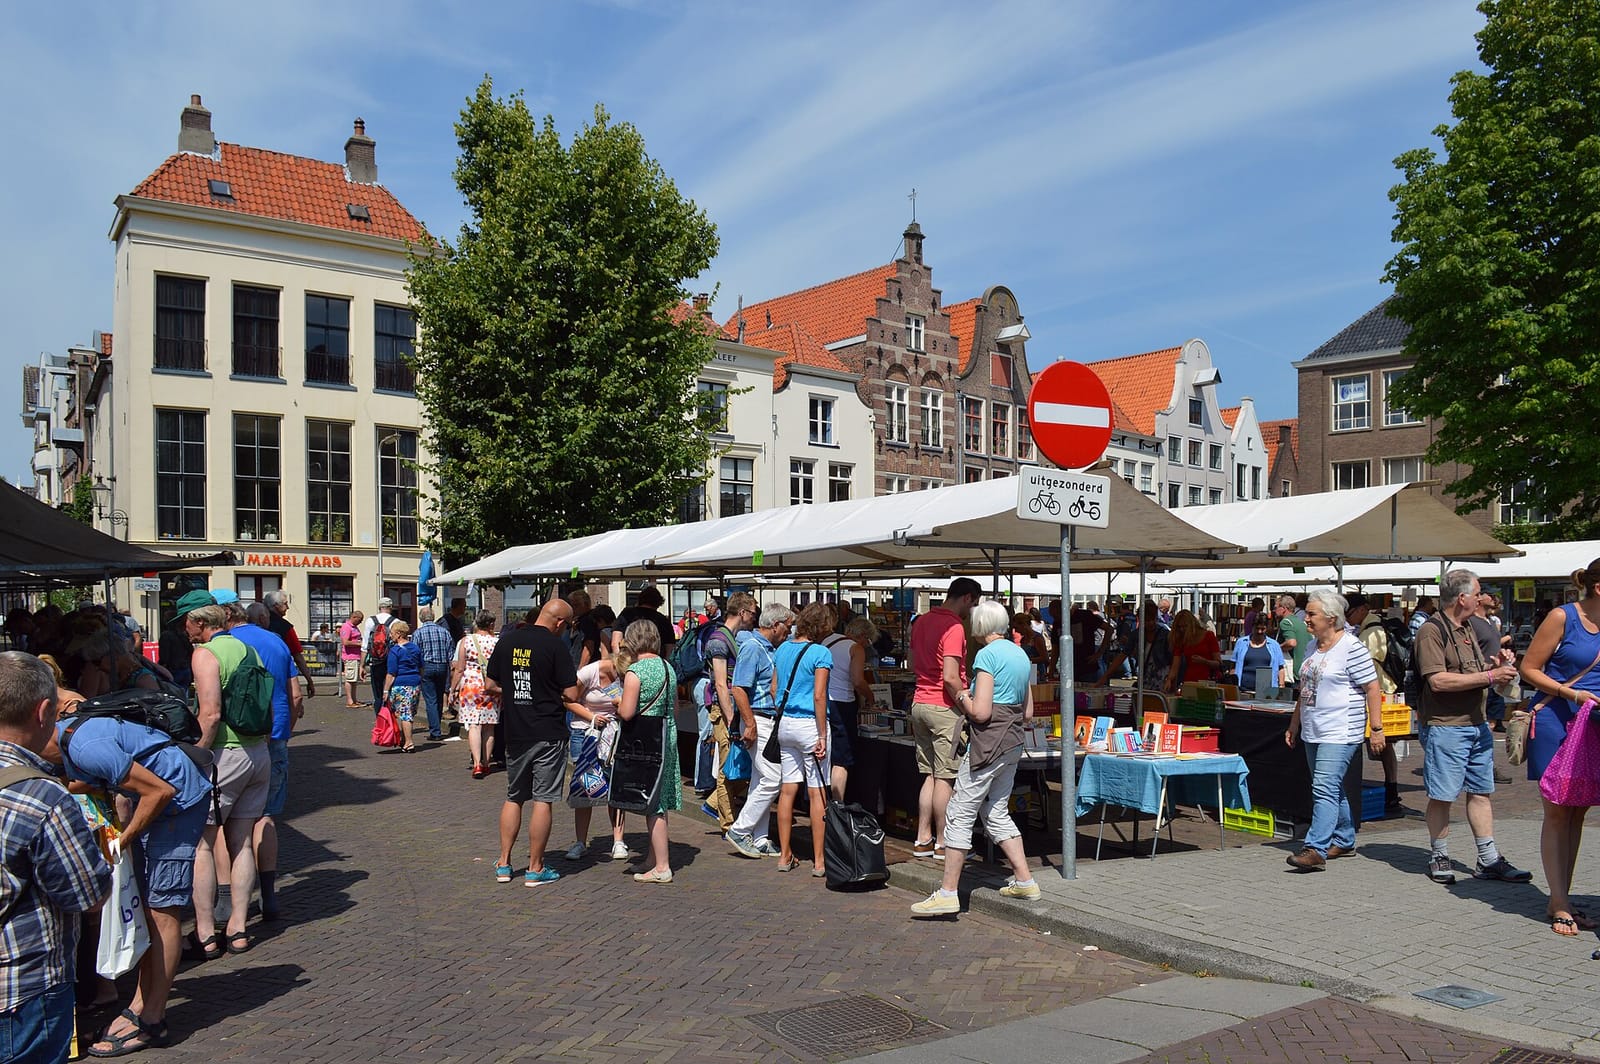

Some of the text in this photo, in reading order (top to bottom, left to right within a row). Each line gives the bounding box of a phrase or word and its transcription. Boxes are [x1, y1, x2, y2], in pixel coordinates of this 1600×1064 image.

[1030, 475, 1103, 494] uitgezonderd
[247, 553, 343, 569] MAKELAARS
[513, 647, 532, 658] MIJN
[512, 657, 531, 667] BOEK
[512, 670, 531, 681] MIJN
[513, 680, 531, 691] VER
[513, 690, 533, 700] HAAL
